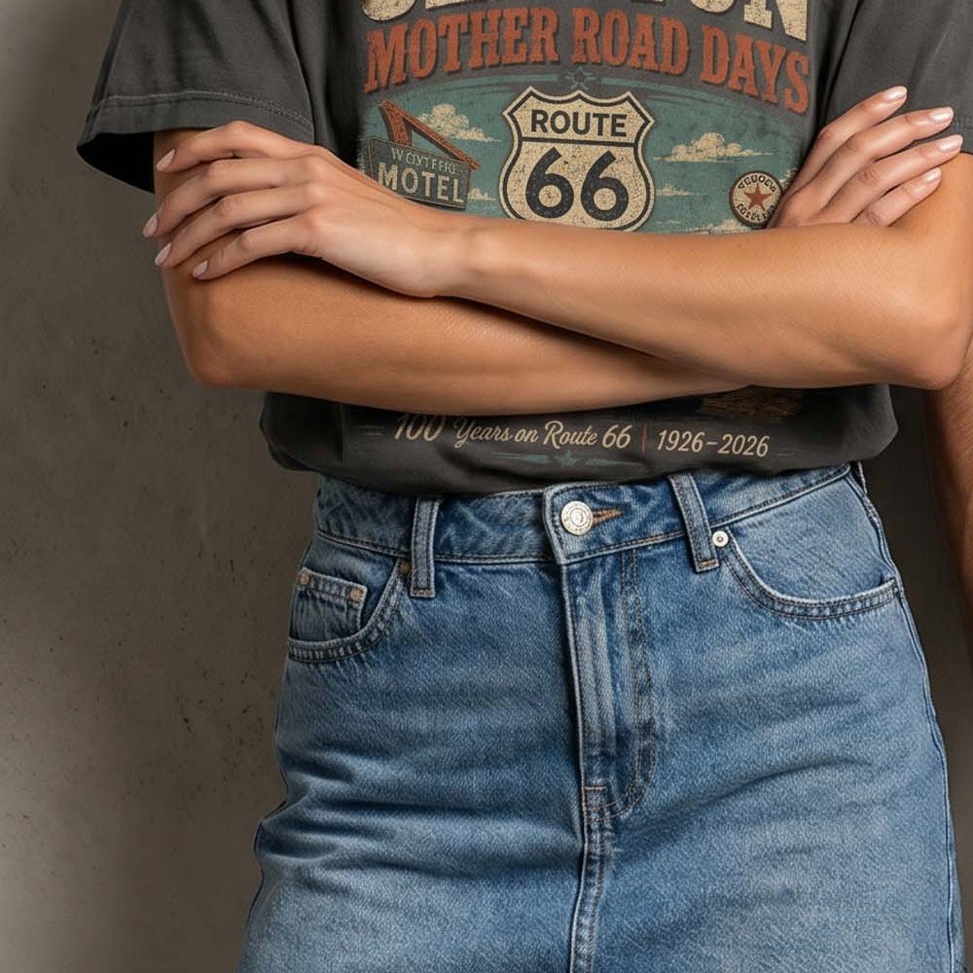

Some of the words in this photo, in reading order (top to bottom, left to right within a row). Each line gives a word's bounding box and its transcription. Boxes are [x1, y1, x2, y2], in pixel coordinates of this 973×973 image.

[363, 5, 560, 94] MOTHER
[571, 6, 690, 76] ROAD
[700, 24, 812, 115] DAYS
[531, 110, 628, 138] ROUTE
[378, 162, 464, 203] MOTEL
[525, 147, 630, 220] 66
[394, 413, 446, 441] 100
[454, 418, 513, 448] Years
[514, 428, 539, 443] on
[543, 420, 599, 448] Route
[602, 423, 632, 449] 66
[657, 429, 770, 458] 1926-2026
